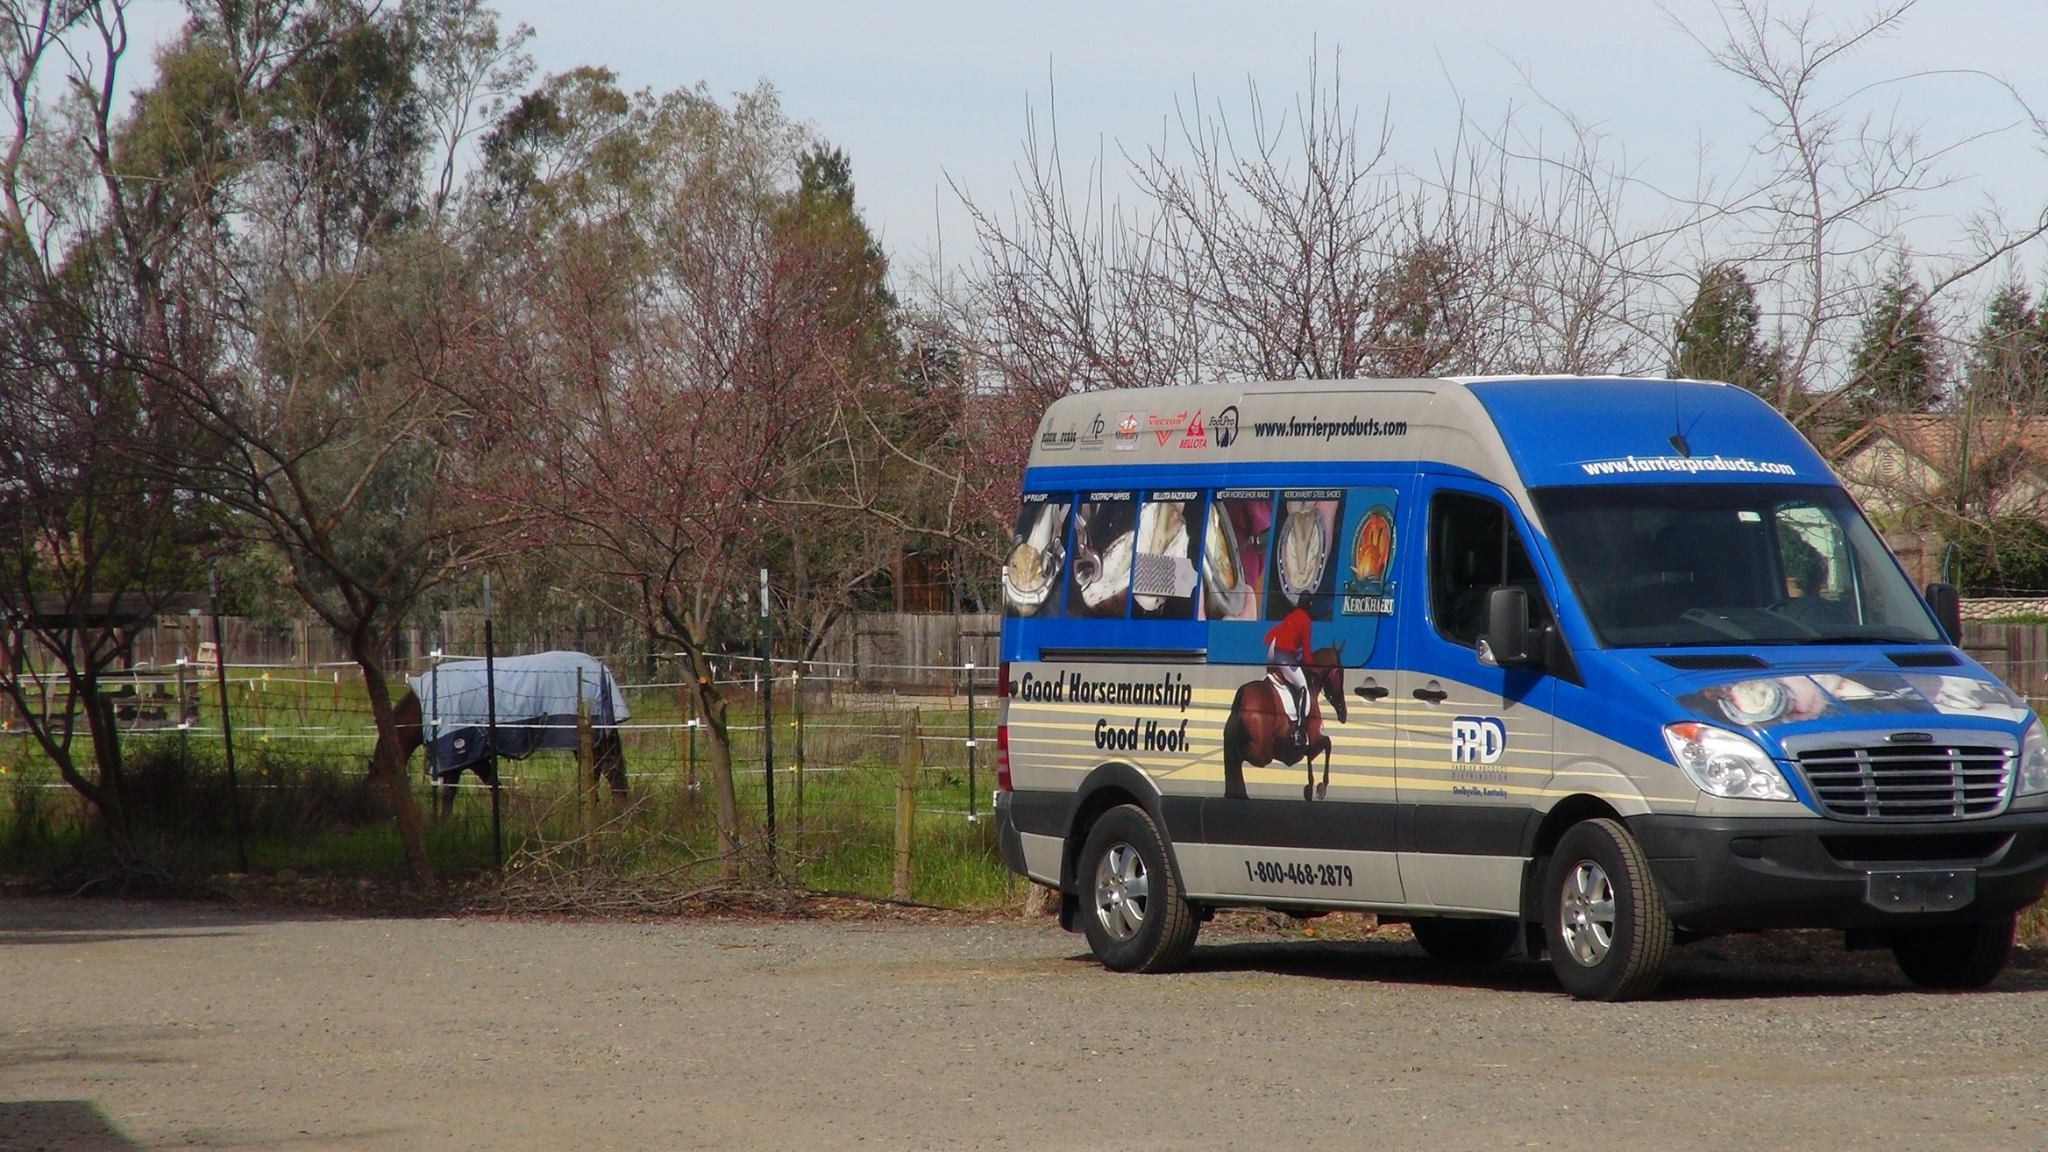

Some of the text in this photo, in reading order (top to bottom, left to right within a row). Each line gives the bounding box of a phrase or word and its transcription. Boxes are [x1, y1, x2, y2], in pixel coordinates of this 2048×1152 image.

[1254, 416, 1407, 442] www.farrierproducts.com
[1179, 439, 1207, 449] BELLOTA
[1582, 454, 1796, 476] www.farrierproducts.com
[1021, 670, 1192, 712] Good Horsemanship
[1094, 717, 1190, 752] Good Hoof.
[1451, 716, 1506, 764] FPD
[1245, 861, 1353, 887] 1-800-468-2879
